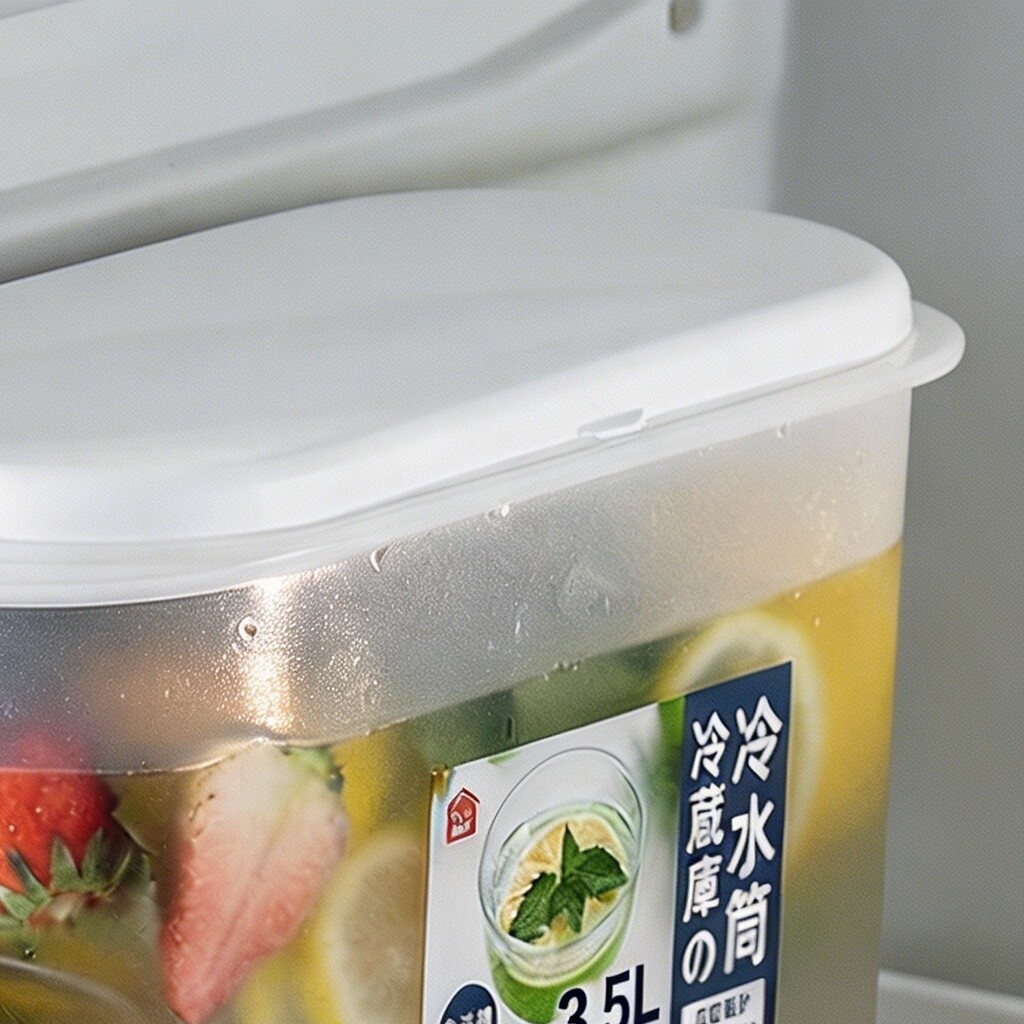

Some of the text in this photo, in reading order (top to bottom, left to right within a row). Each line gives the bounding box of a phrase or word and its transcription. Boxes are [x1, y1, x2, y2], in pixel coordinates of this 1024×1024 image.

[681, 711, 730, 984] 冷蔵庫の
[723, 695, 783, 975] 冷水筒
